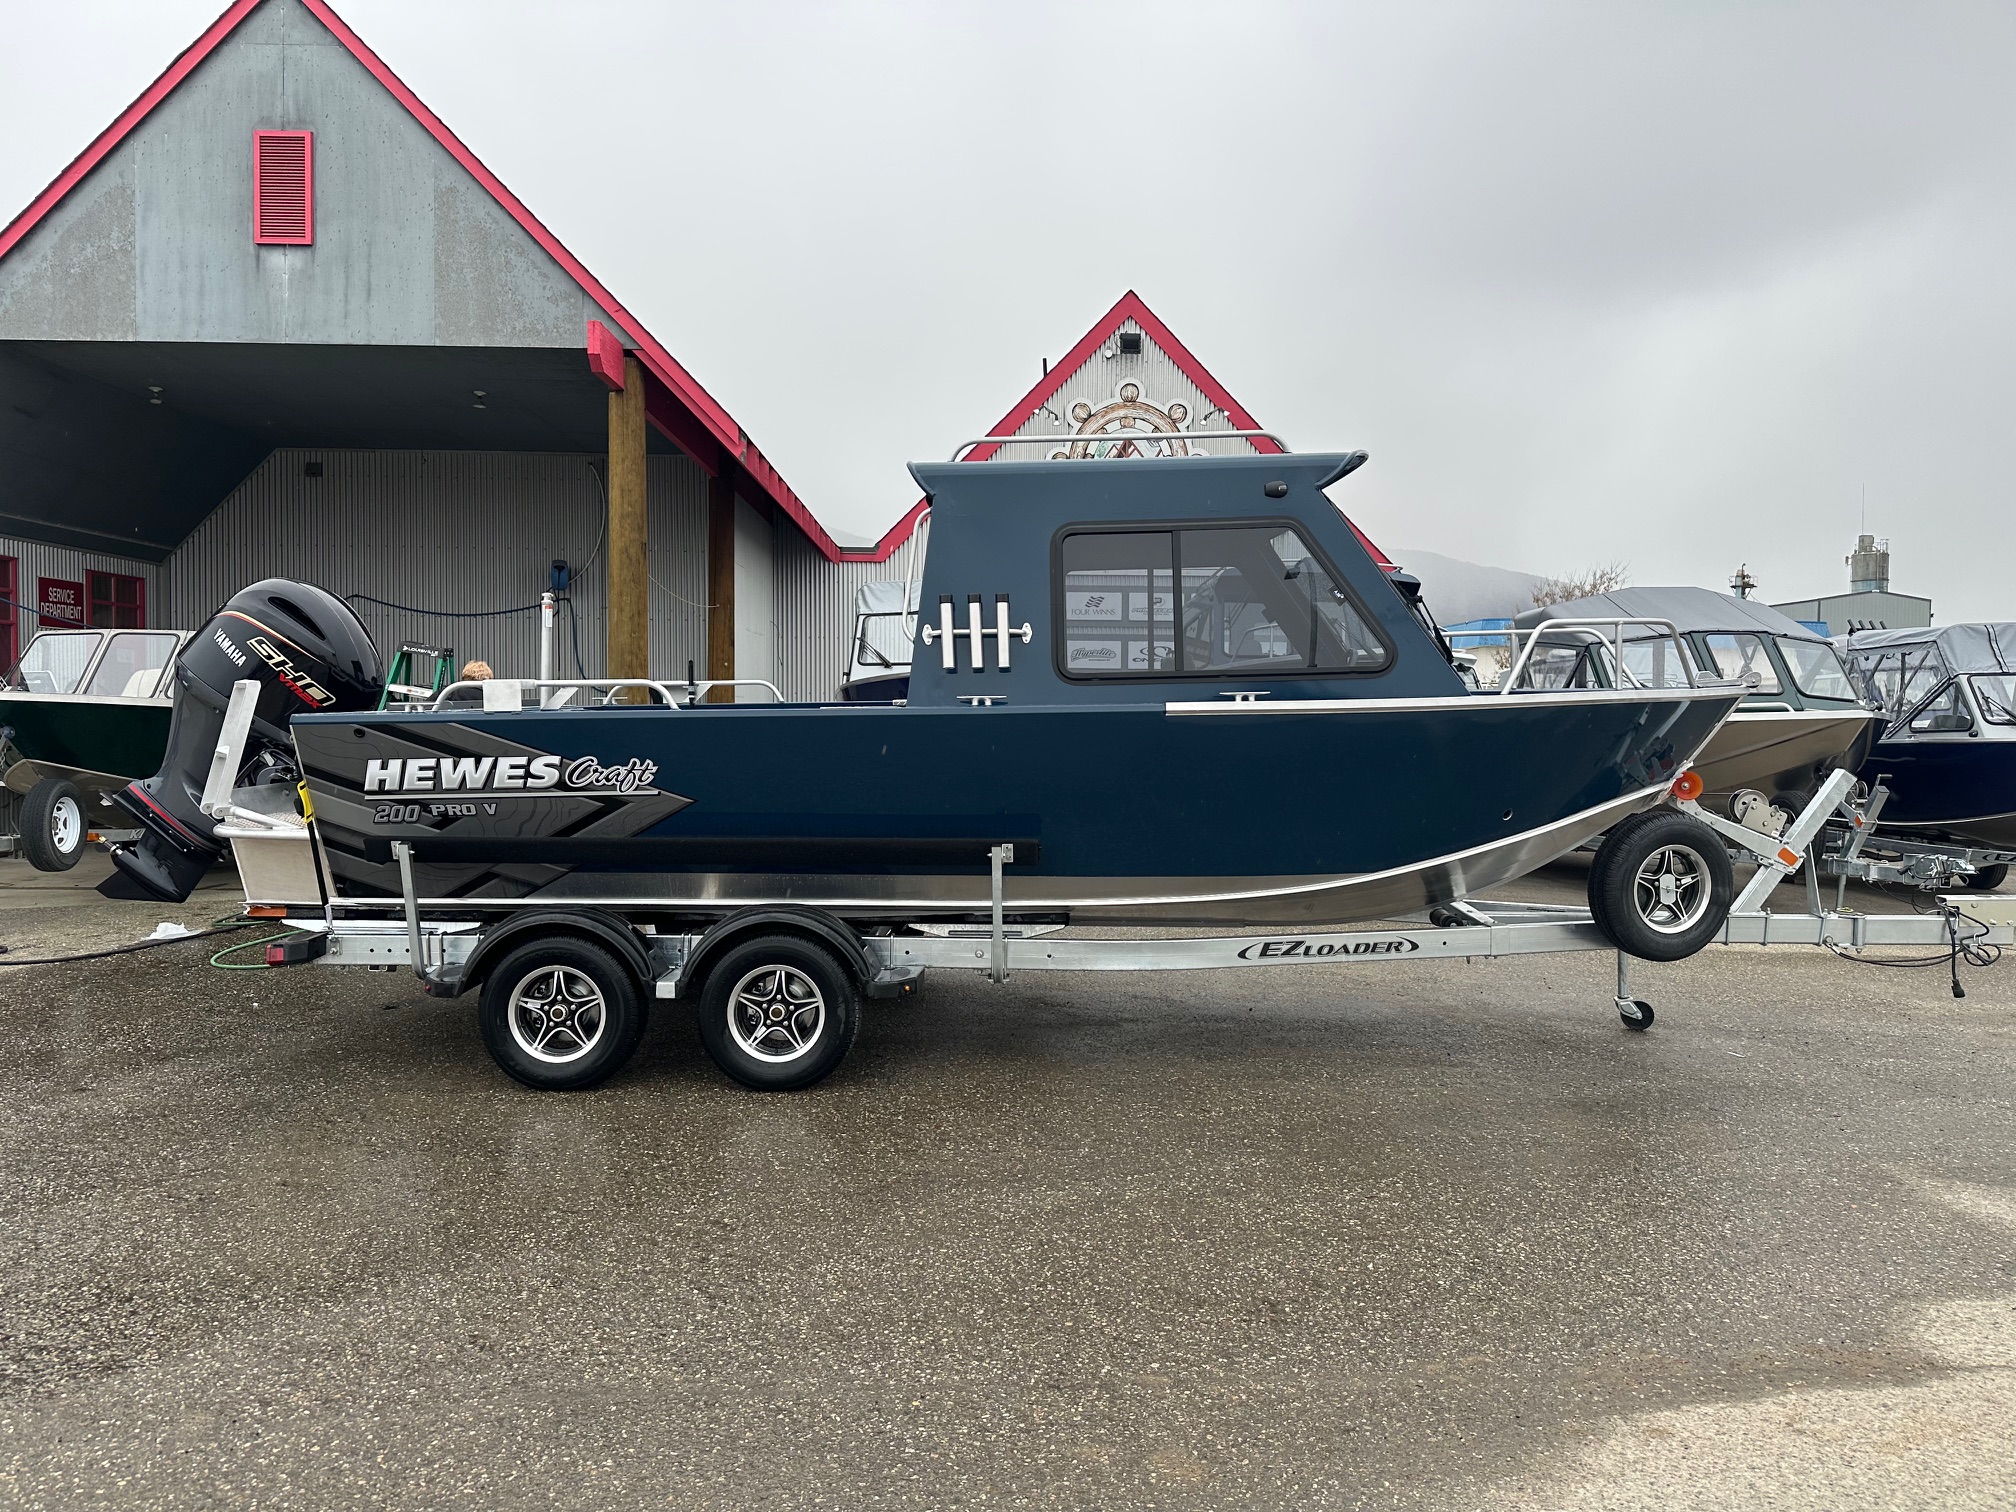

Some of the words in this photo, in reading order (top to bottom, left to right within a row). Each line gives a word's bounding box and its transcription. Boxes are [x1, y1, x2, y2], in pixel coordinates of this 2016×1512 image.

[48, 586, 75, 604] SERVICE
[40, 602, 82, 619] DEPARTMENT
[1071, 608, 1091, 616] FOUR
[1092, 608, 1116, 616] WINNS
[213, 627, 247, 668] YAMAHA
[246, 636, 337, 707] SHO
[364, 755, 562, 792] HEWES
[565, 756, 659, 794] Craft
[374, 804, 421, 824] 200
[429, 803, 476, 817] PRO
[482, 802, 498, 816] V
